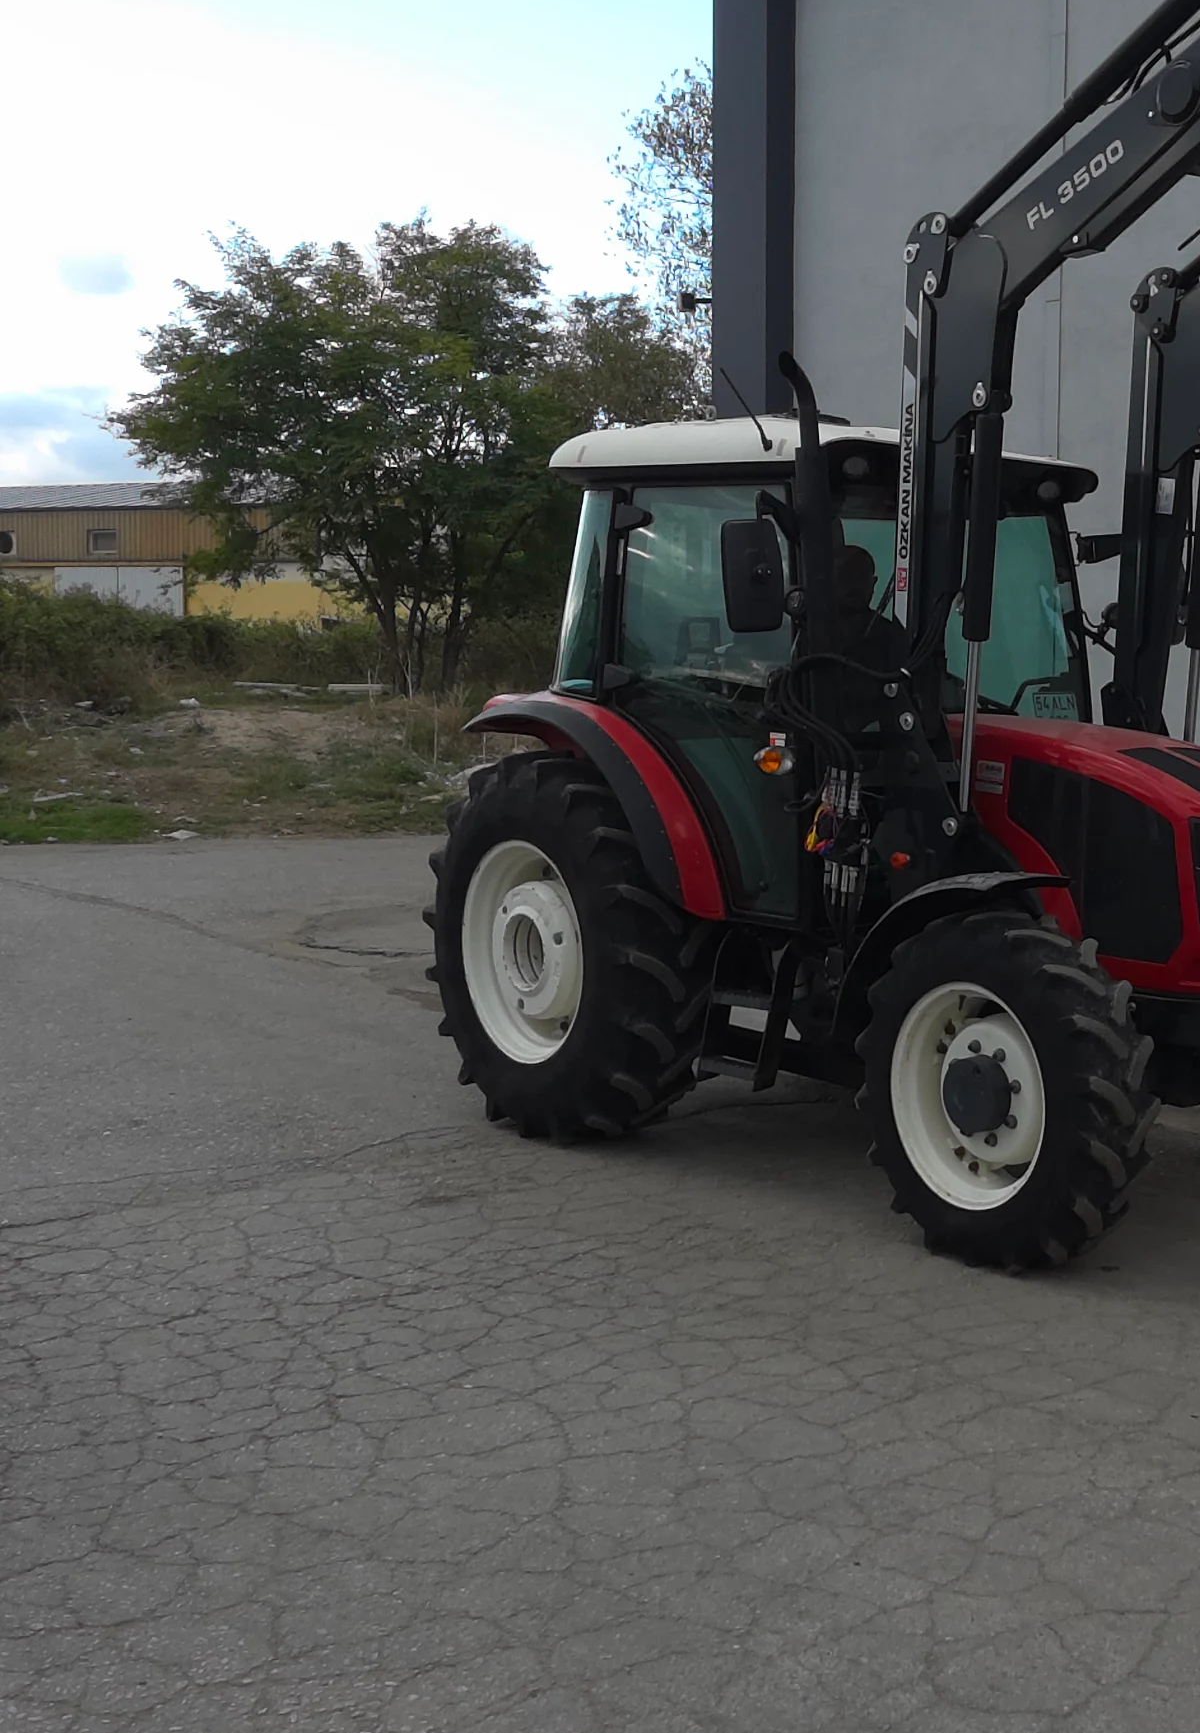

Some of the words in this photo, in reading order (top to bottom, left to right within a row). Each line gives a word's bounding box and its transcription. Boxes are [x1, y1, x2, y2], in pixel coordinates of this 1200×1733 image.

[1026, 201, 1055, 230] FL
[1057, 139, 1124, 204] 3500
[902, 403, 914, 484] MAKİNA
[898, 489, 911, 560] ÖZKAN
[1035, 695, 1049, 710] 54
[1052, 695, 1076, 711] ALN
